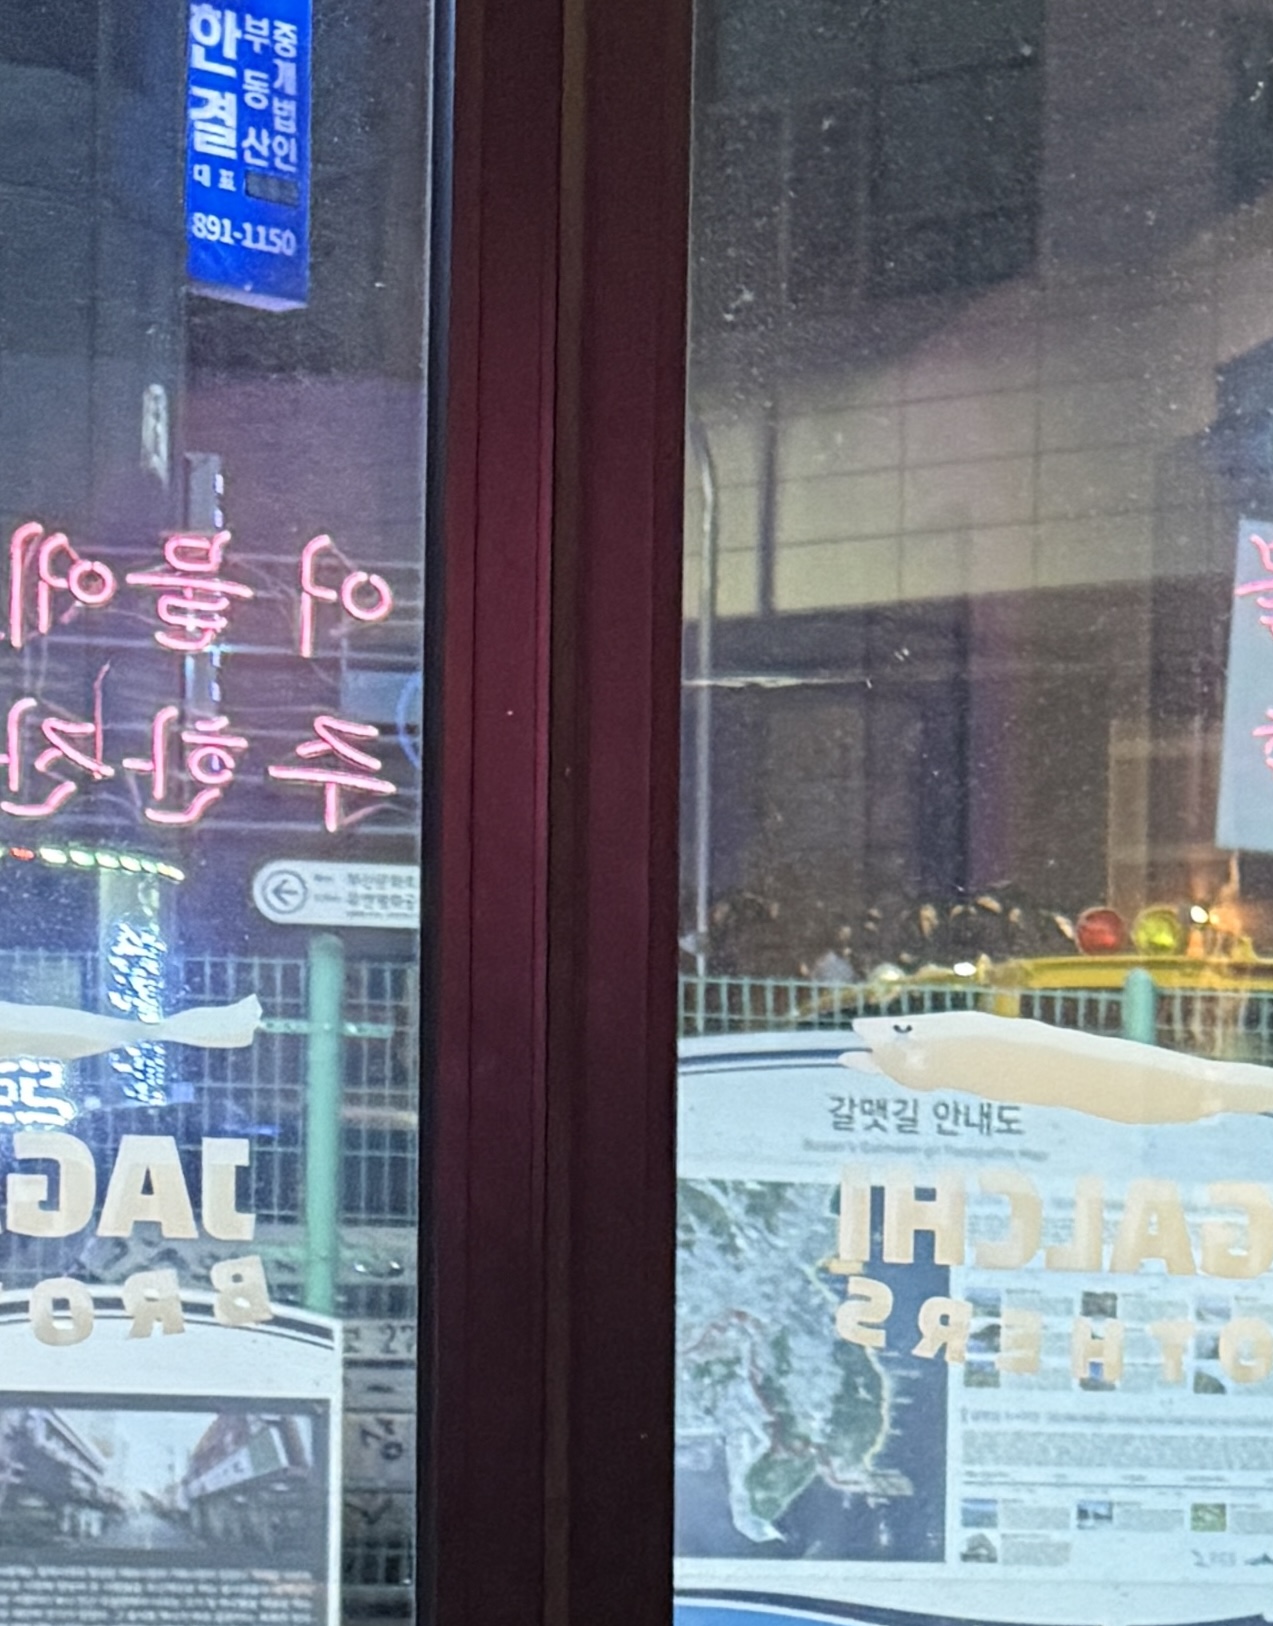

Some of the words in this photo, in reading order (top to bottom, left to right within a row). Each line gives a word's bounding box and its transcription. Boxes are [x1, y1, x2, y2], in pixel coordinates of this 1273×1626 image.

[190, 3, 237, 160] 한결
[242, 13, 271, 168] 부동산
[272, 19, 298, 173] 중개법인
[192, 212, 297, 257] 891-1150
[829, 1095, 919, 1135] 갈맷길
[932, 1099, 1026, 1136] 안내도
